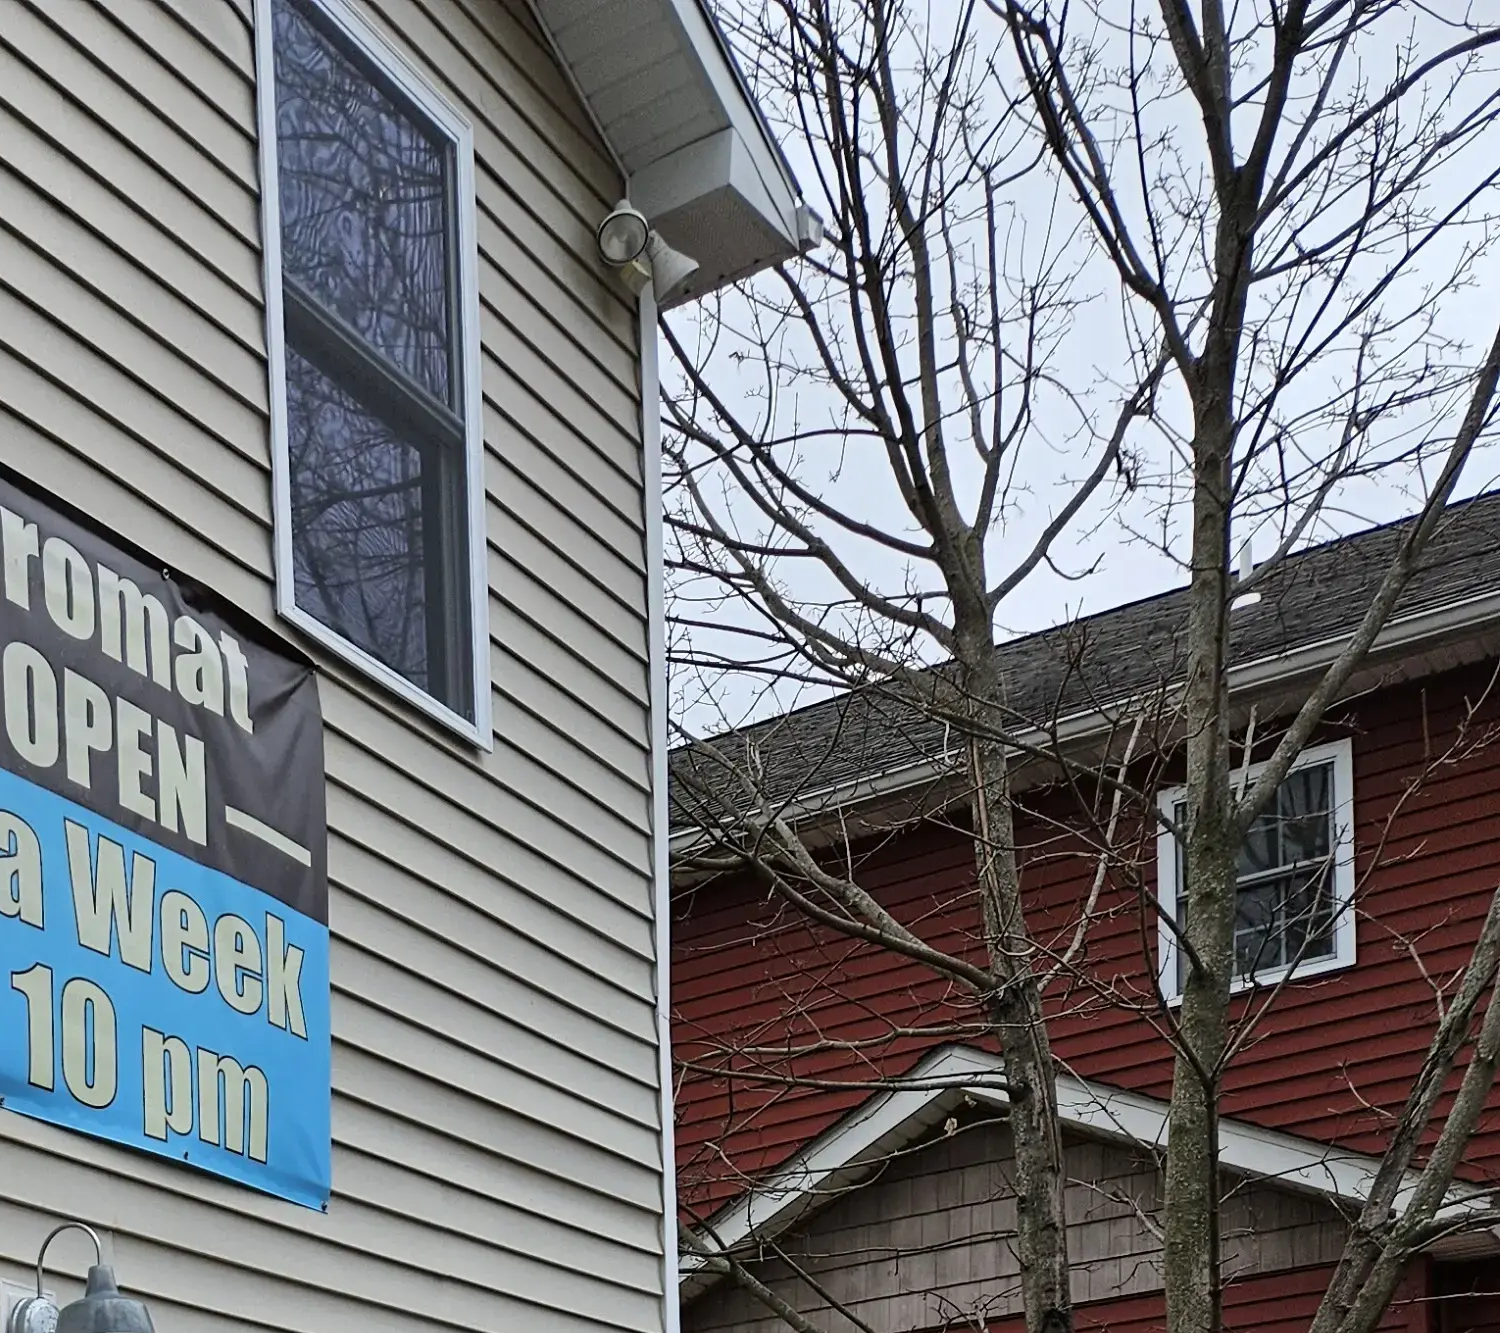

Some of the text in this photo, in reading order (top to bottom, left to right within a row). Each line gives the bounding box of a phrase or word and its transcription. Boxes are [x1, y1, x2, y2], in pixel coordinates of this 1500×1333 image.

[2, 641, 207, 848] OPEN
[63, 818, 308, 1038] Week
[11, 962, 118, 1111] 10
[142, 1025, 270, 1163] pm
